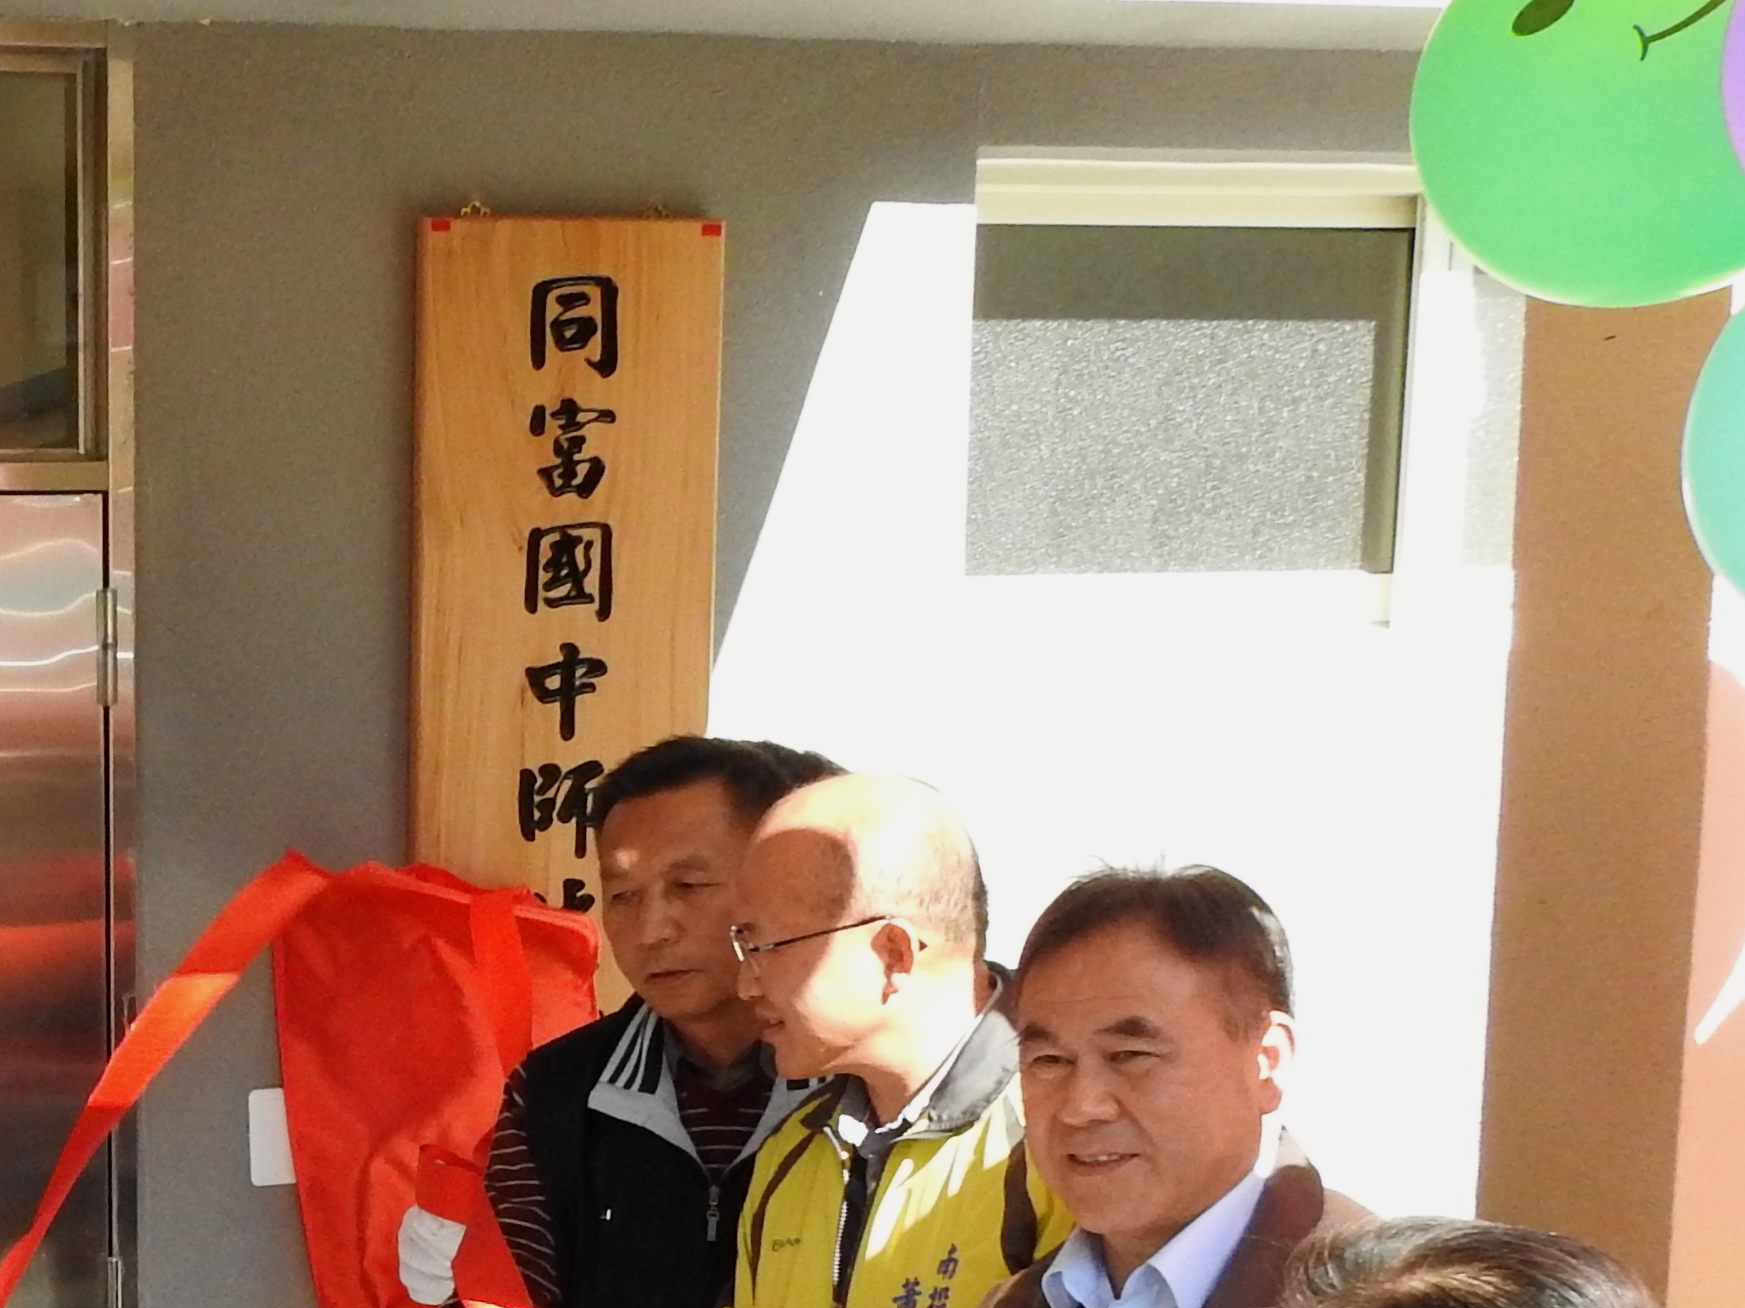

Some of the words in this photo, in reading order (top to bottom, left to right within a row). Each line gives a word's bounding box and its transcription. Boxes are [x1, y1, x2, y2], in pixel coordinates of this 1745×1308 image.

[518, 275, 619, 912] 同富國中師
